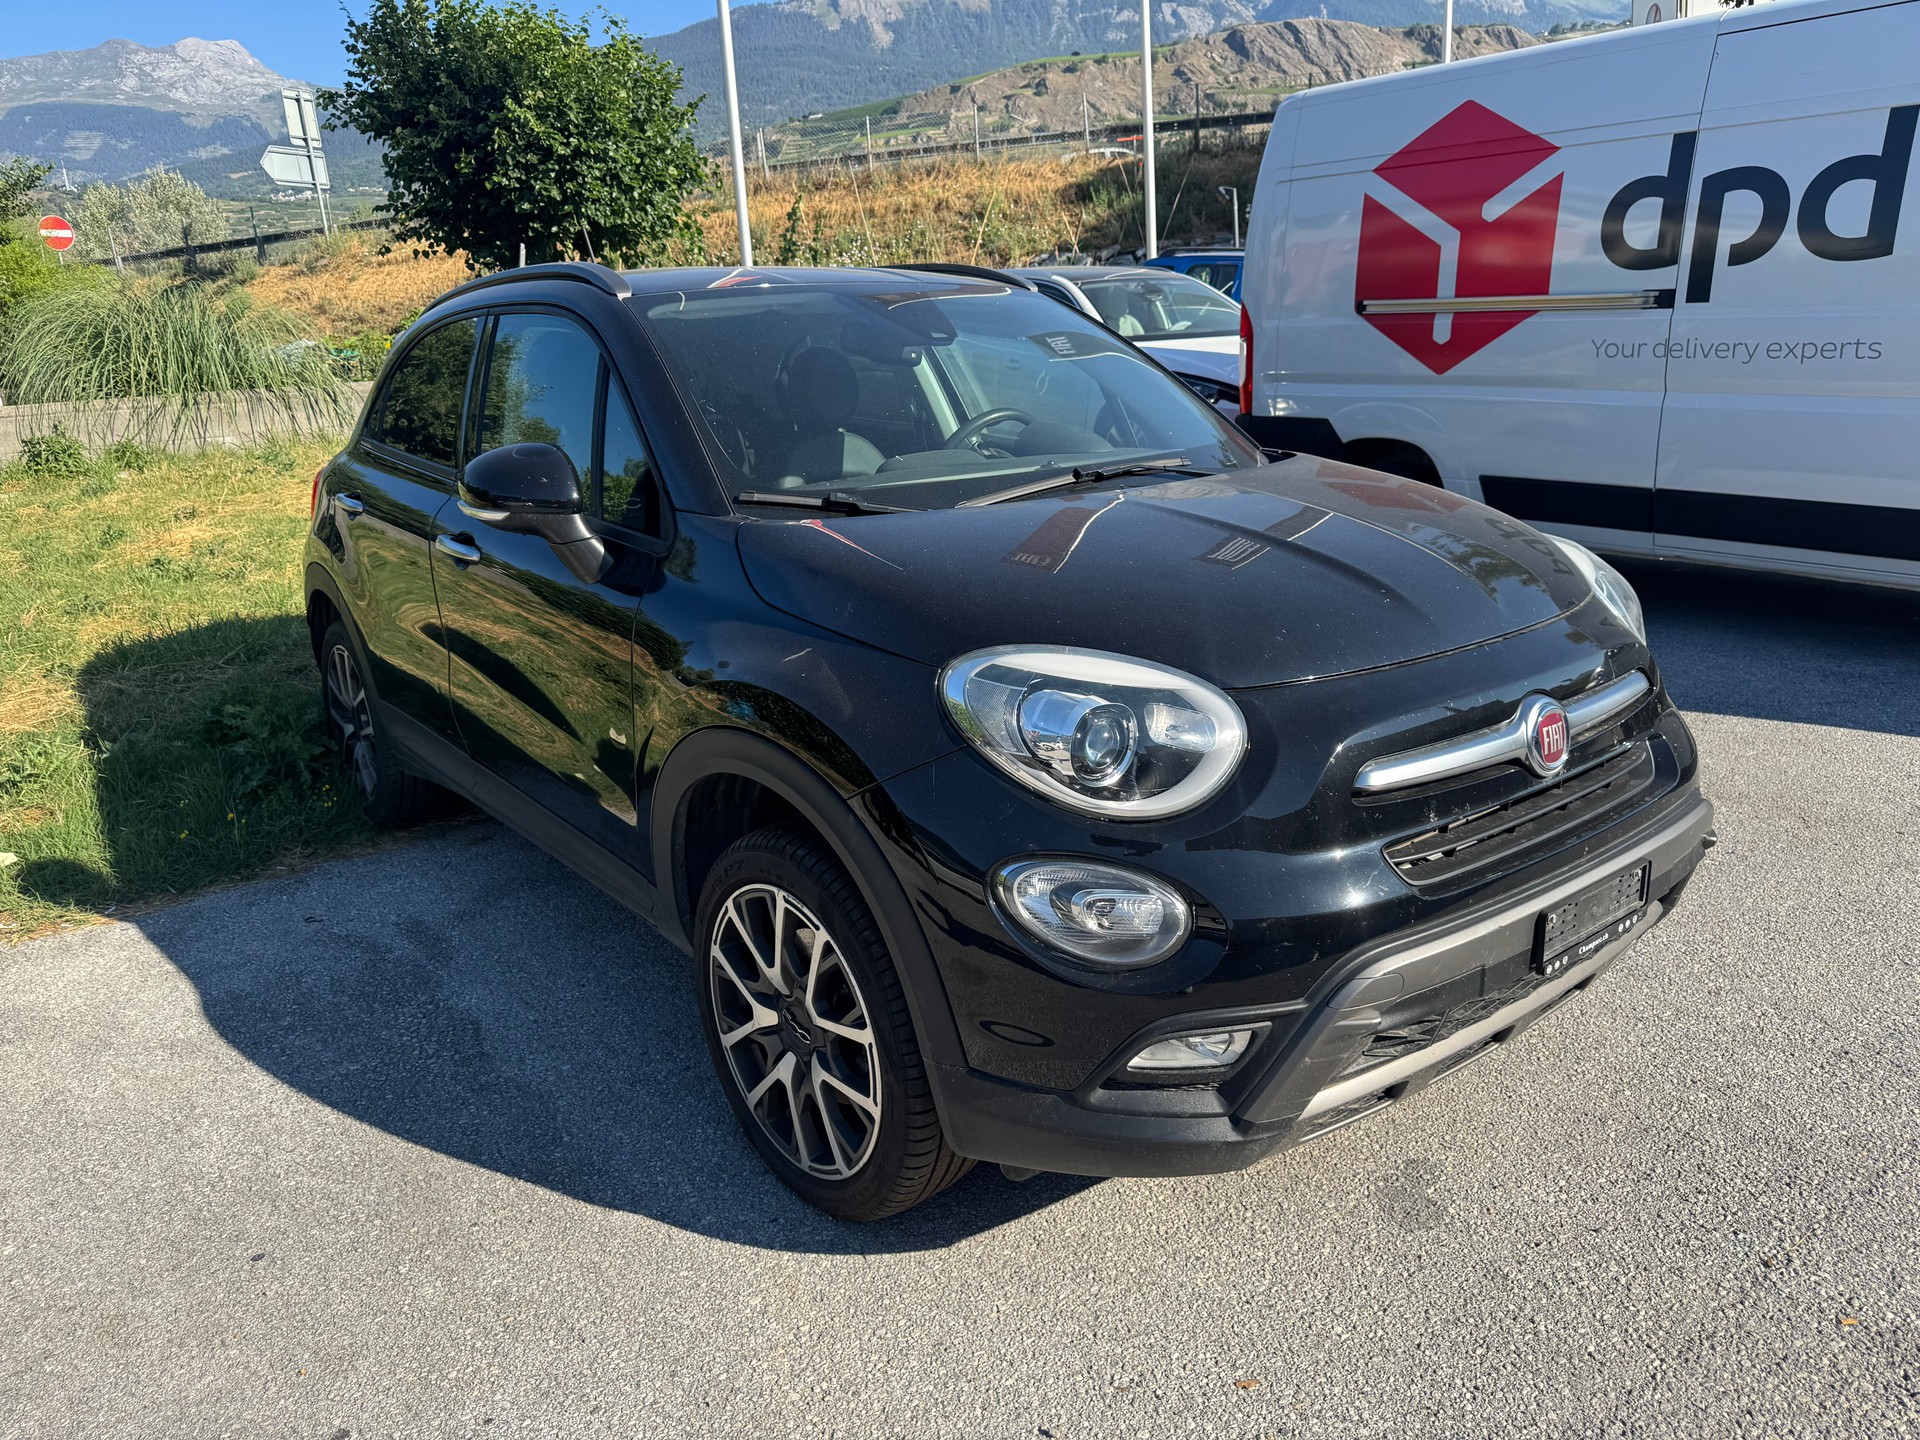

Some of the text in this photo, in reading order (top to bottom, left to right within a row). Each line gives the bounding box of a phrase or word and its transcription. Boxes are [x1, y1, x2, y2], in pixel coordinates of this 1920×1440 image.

[1600, 104, 1920, 304] dpd
[1045, 335, 1077, 355] FIAT
[1591, 337, 1882, 364] Your delivery experts
[1542, 721, 1563, 756] FIAT
